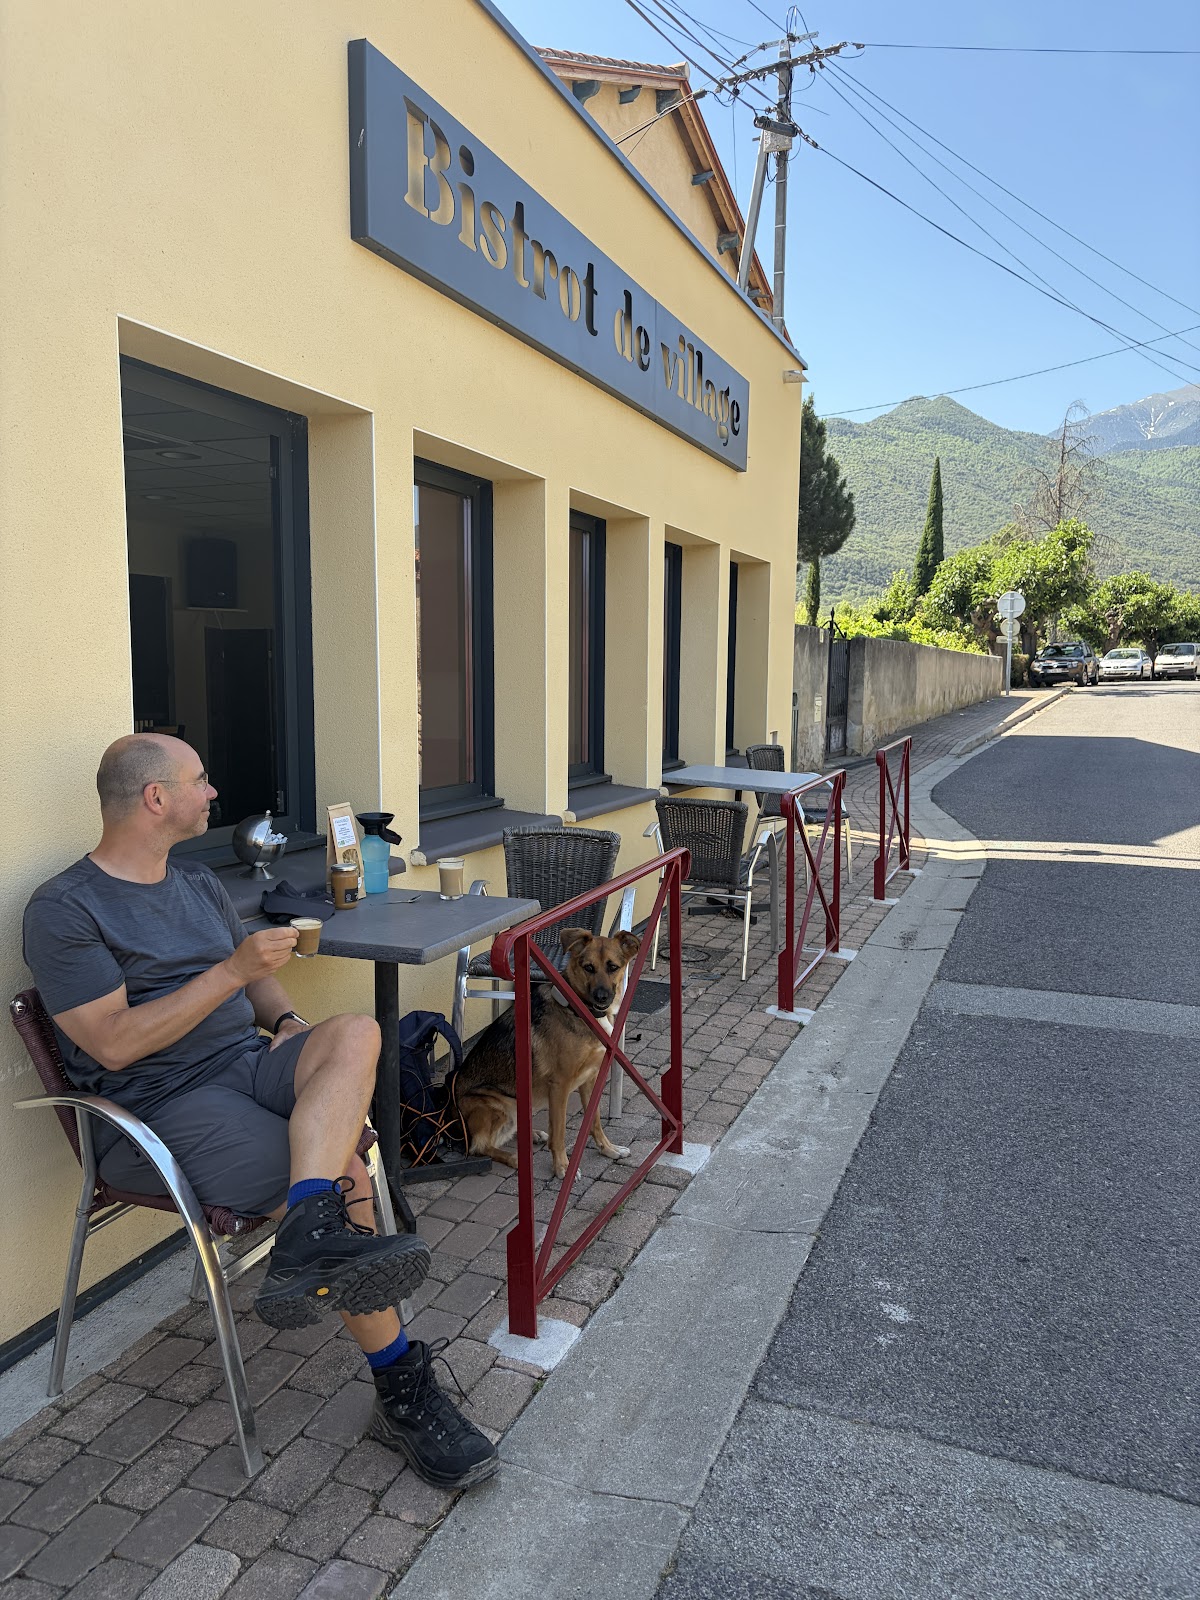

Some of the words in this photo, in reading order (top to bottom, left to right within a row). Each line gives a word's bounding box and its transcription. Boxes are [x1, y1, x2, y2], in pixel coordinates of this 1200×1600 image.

[403, 95, 598, 336] Bistrot
[614, 290, 650, 371] de
[660, 334, 740, 446] village
